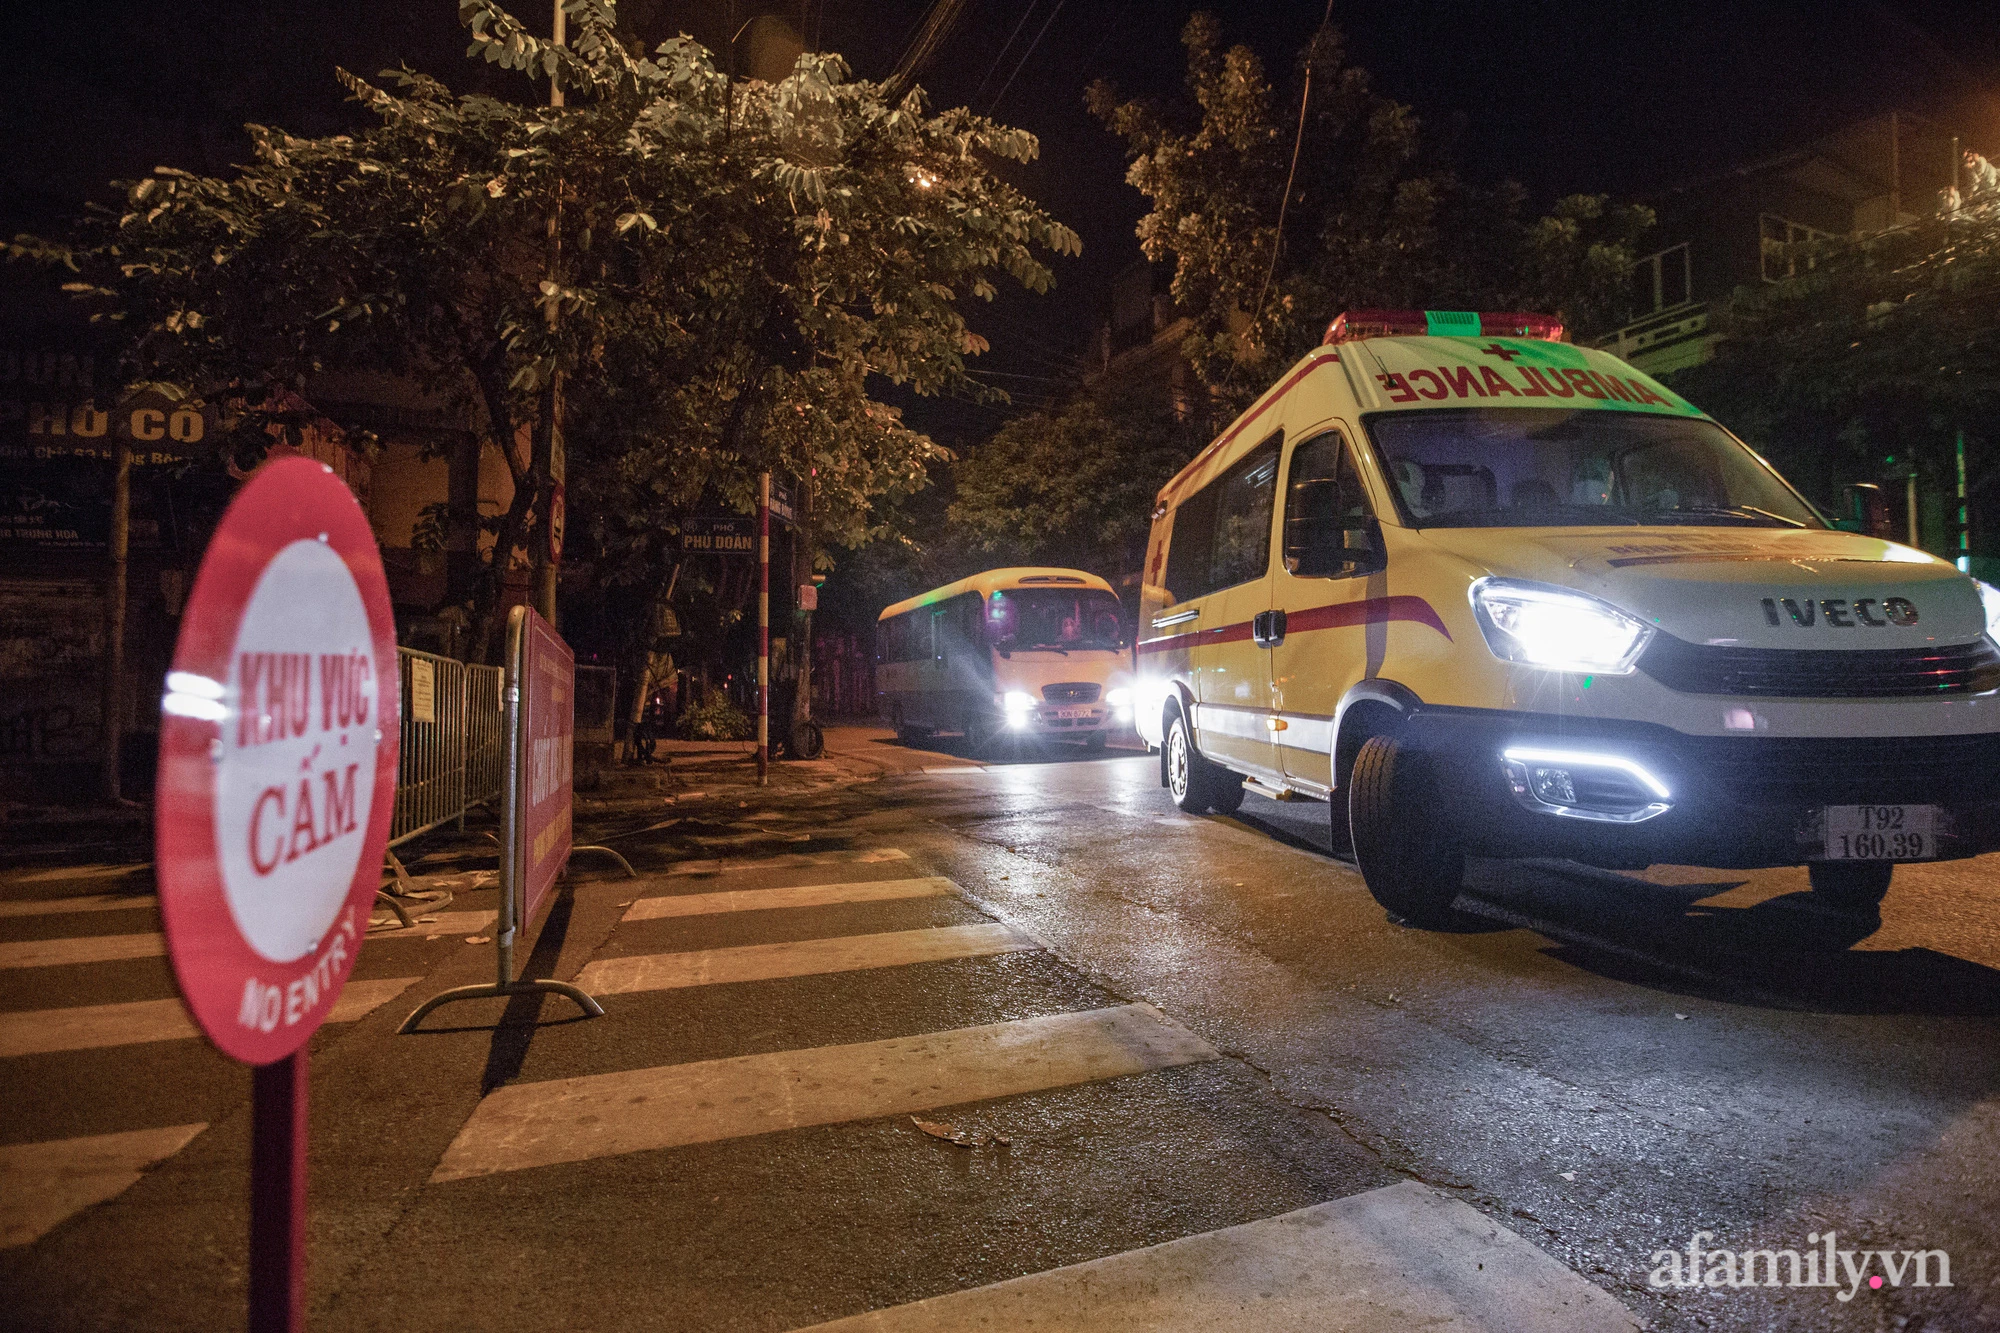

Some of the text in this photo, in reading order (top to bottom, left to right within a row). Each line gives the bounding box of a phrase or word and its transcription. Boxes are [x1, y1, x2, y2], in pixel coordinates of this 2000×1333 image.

[1760, 596, 1919, 627] IVECO
[236, 652, 310, 748] KHU
[320, 647, 370, 746] VỰC
[247, 744, 360, 878] CẤM
[1859, 806, 1904, 830] T92
[1840, 833, 1922, 858] 160.39
[237, 905, 357, 1032] NO ENTRY
